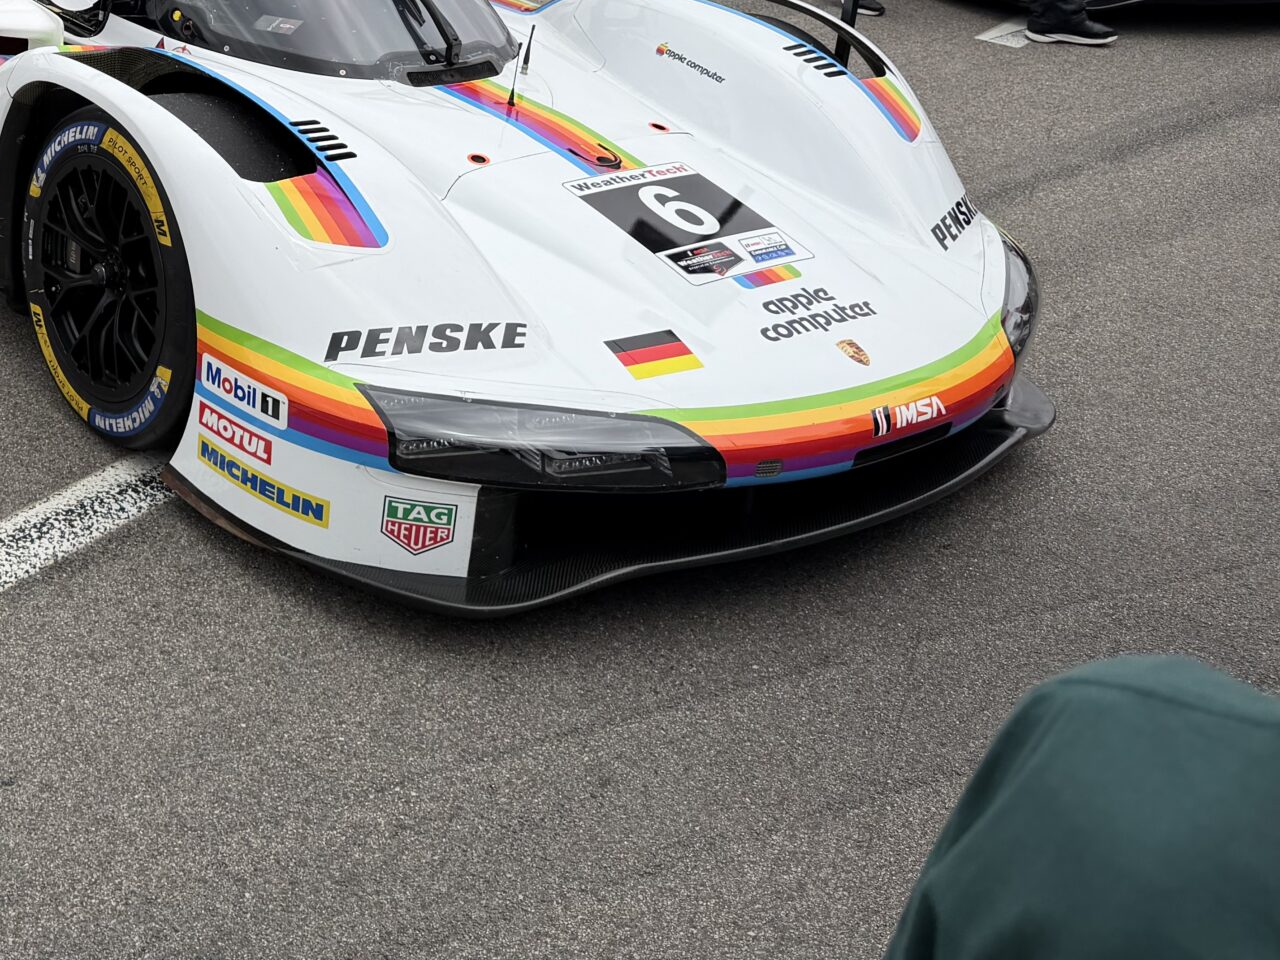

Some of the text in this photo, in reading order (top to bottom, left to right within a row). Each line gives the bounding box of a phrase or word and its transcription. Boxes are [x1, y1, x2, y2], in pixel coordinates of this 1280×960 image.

[665, 48, 726, 84] apple computer
[43, 125, 98, 170] MICHELIN
[107, 137, 128, 156] PILOT
[126, 156, 148, 186] SPORT
[569, 164, 688, 192] WeatherTech
[638, 185, 720, 235] 6
[677, 248, 734, 267] WeatherTech
[762, 287, 836, 316] apple
[760, 300, 878, 342] computer
[324, 322, 527, 363] PENSKE
[206, 360, 278, 419] Mobil 1
[95, 396, 155, 433] MICHELIN
[895, 395, 947, 429] IMSA
[201, 407, 269, 460] MOTUL
[201, 439, 324, 522] MICHELIN
[391, 501, 449, 523] TAG
[387, 521, 448, 548] HEUER
